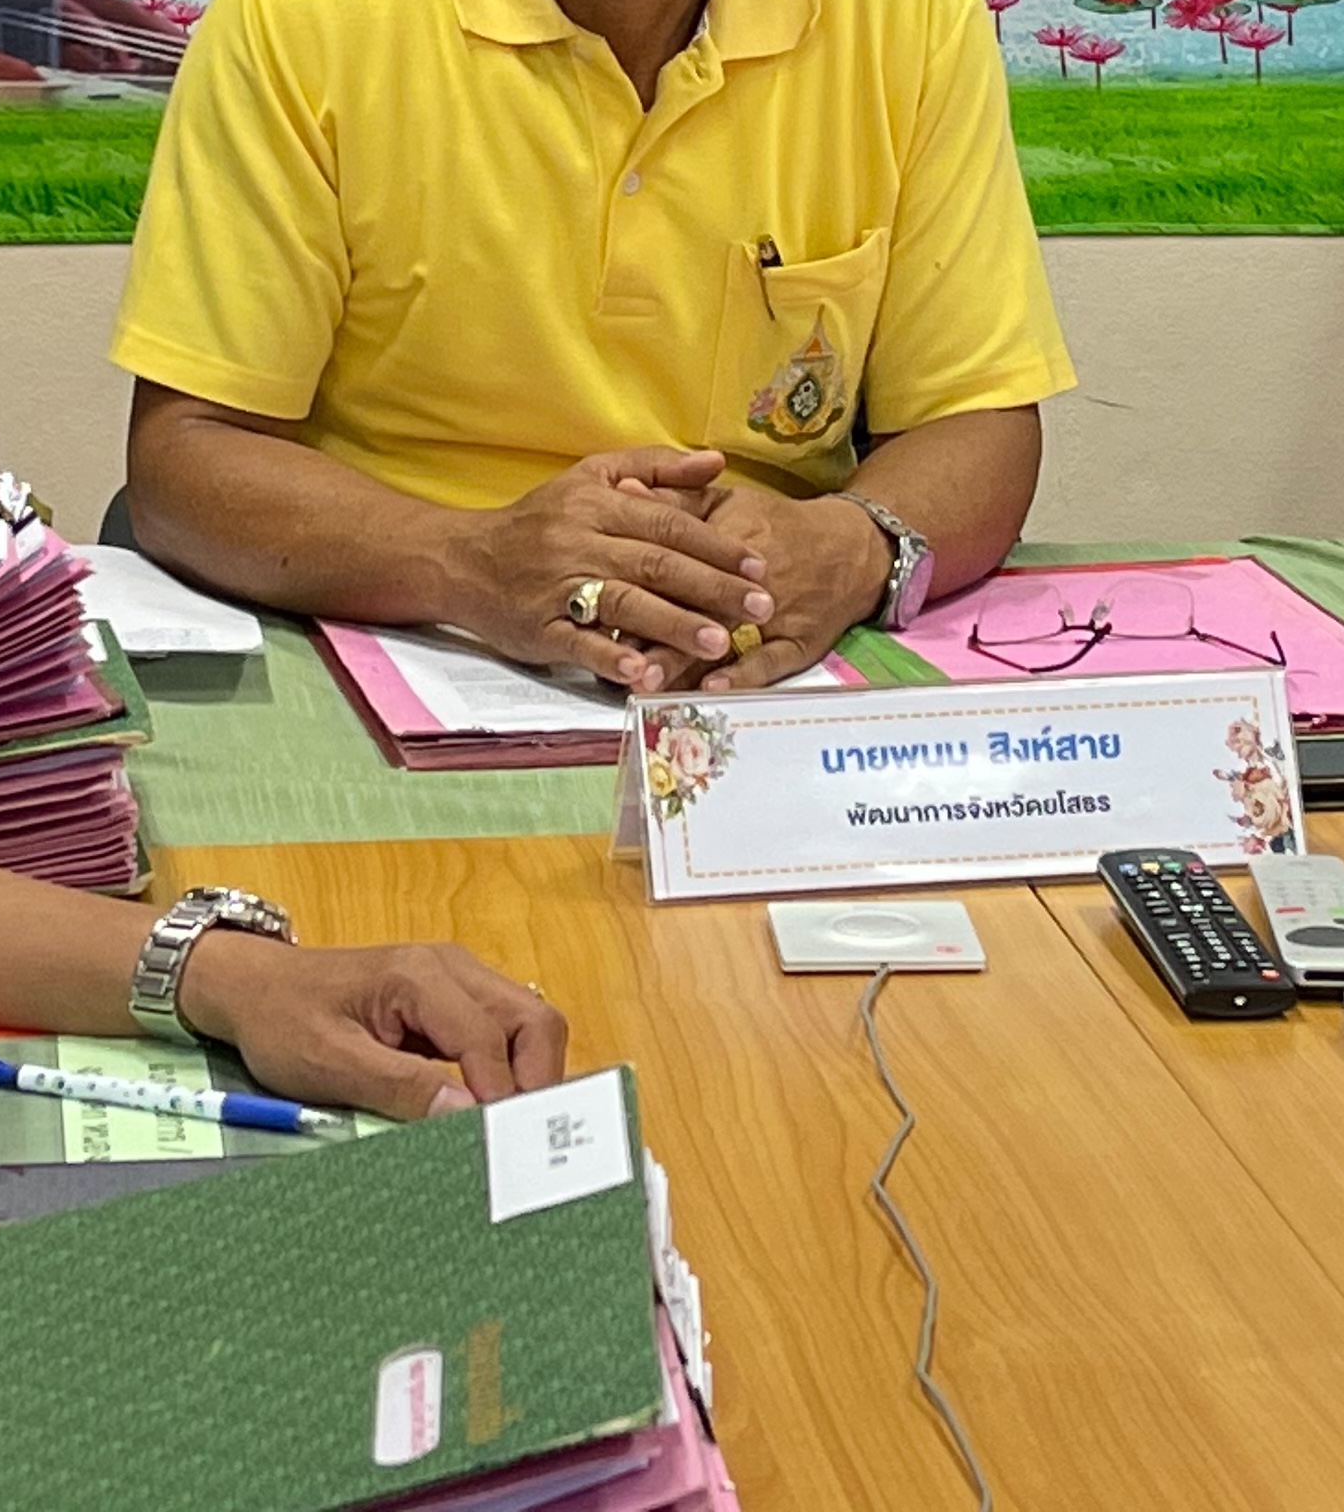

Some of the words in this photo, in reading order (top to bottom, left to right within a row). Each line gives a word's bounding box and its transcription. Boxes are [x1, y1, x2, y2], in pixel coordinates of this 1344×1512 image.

[987, 725, 1121, 766] สิงห์สาย
[846, 790, 1111, 827] พัฒนาการจังหวัดยโสธร
